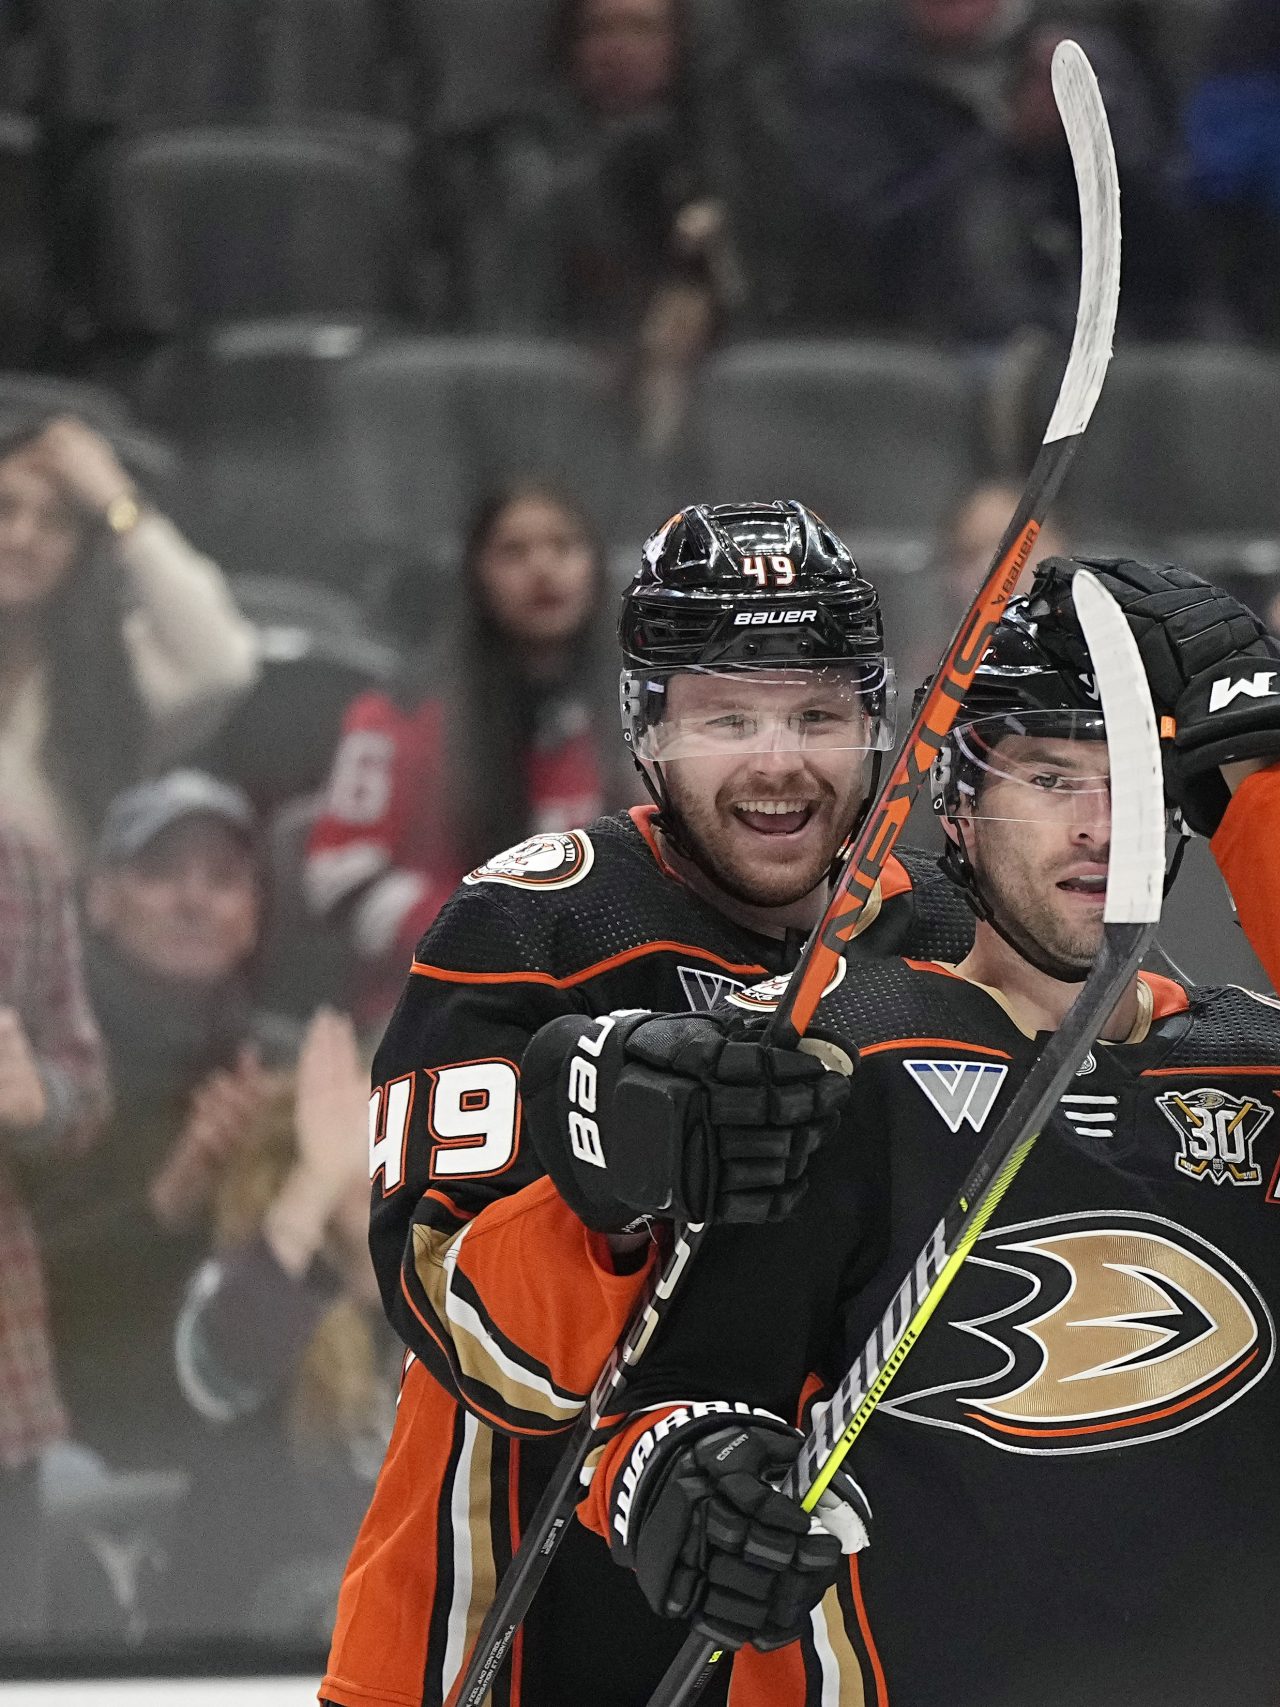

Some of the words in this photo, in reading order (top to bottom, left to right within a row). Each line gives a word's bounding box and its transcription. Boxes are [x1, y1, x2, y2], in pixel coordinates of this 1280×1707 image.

[740, 556, 796, 587] 49
[822, 619, 999, 955] NEXUS
[369, 1056, 522, 1199] 49
[1186, 1107, 1246, 1164] 30
[778, 1217, 953, 1500] RRIOR
[844, 1330, 917, 1434] WARRIOR
[716, 1433, 749, 1461] COVERT
